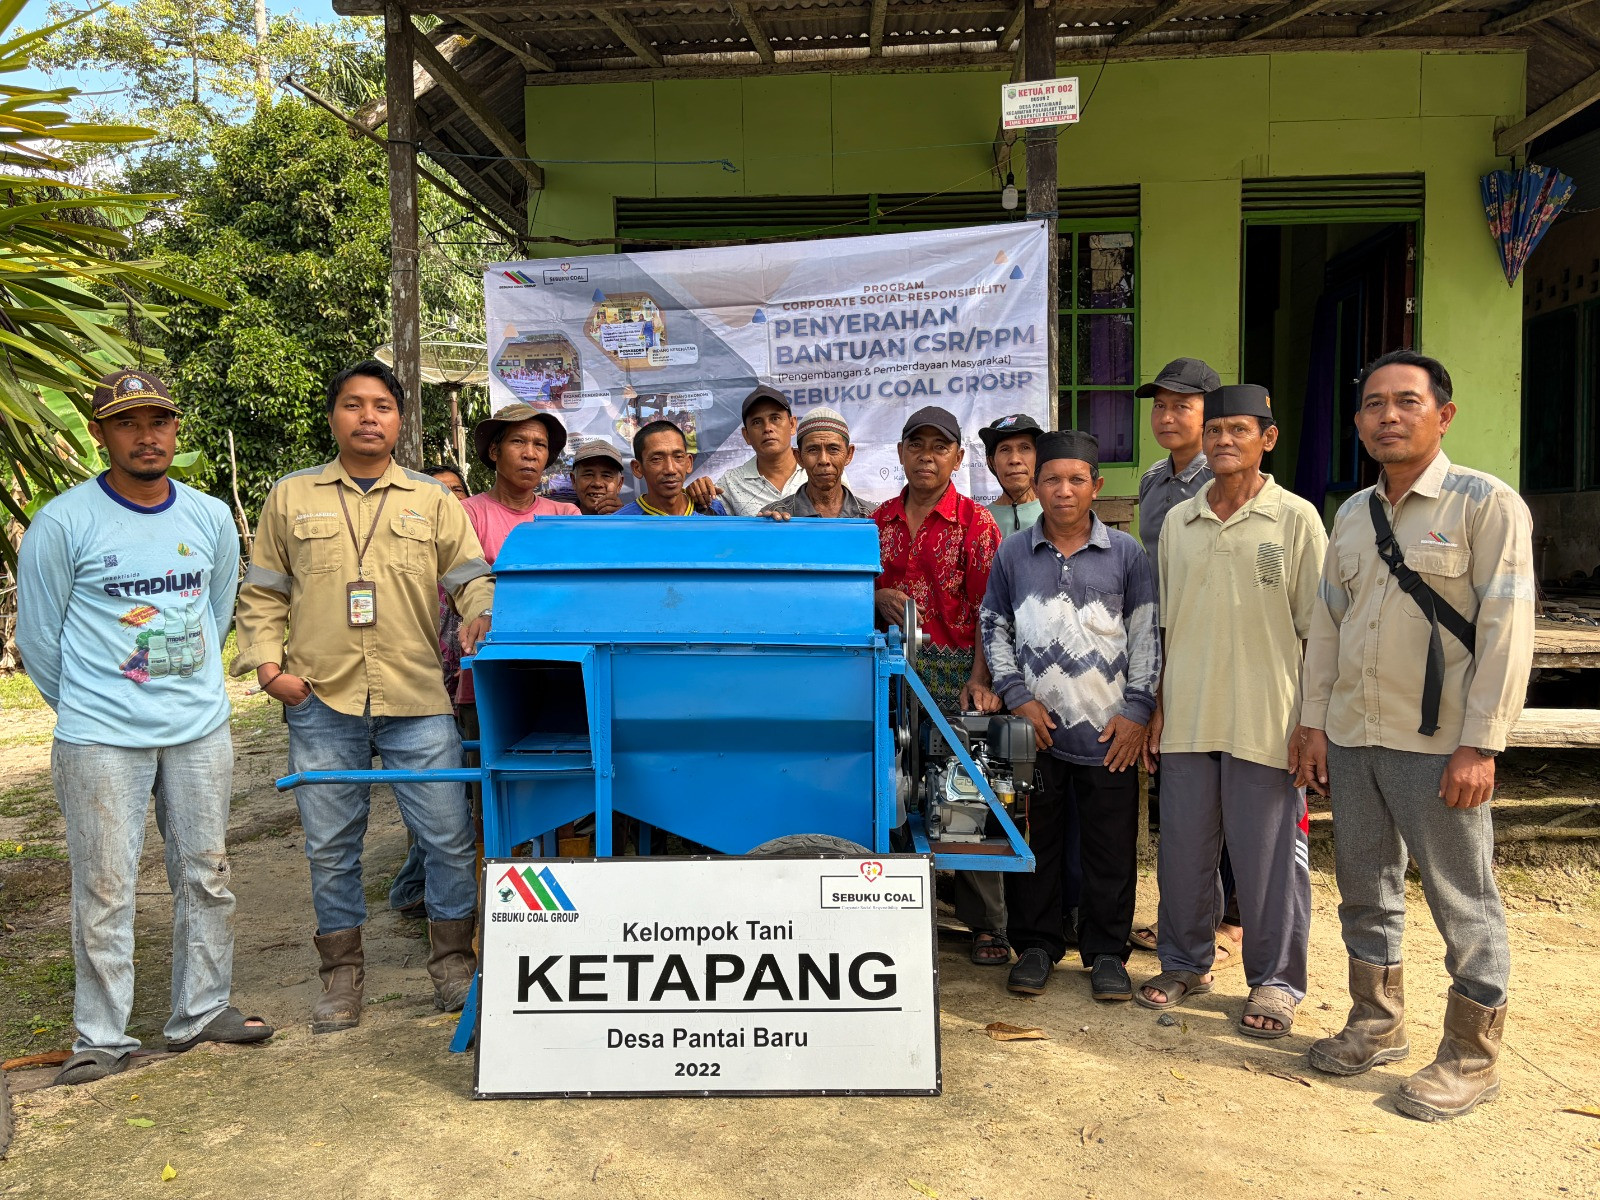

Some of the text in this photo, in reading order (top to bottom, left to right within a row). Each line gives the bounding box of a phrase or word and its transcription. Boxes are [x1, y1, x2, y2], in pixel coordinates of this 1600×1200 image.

[1018, 84, 1073, 97] KETUA RT 002
[782, 284, 1007, 311] CORPORATE SOCIAL RESPONSIBILITY
[863, 281, 924, 294] PROGRAM
[775, 306, 958, 338] PENYERAHAN
[776, 324, 1035, 365] BANTUAN CSR/PPM
[778, 354, 1011, 383] (Pengembangan & Pemberdayaan Masyarakat)
[781, 371, 1033, 406] SEBUKU COAL GROUP
[180, 588, 202, 598] 18 EC
[832, 892, 916, 902] SEBUKU COAL
[491, 912, 580, 923] SEBUKU COAL GROUP
[622, 920, 794, 946] Kelompok Tani
[517, 951, 898, 1002] KETAPANG
[607, 1026, 809, 1050] Desa Pantai Baru
[674, 1062, 721, 1077] 2022
